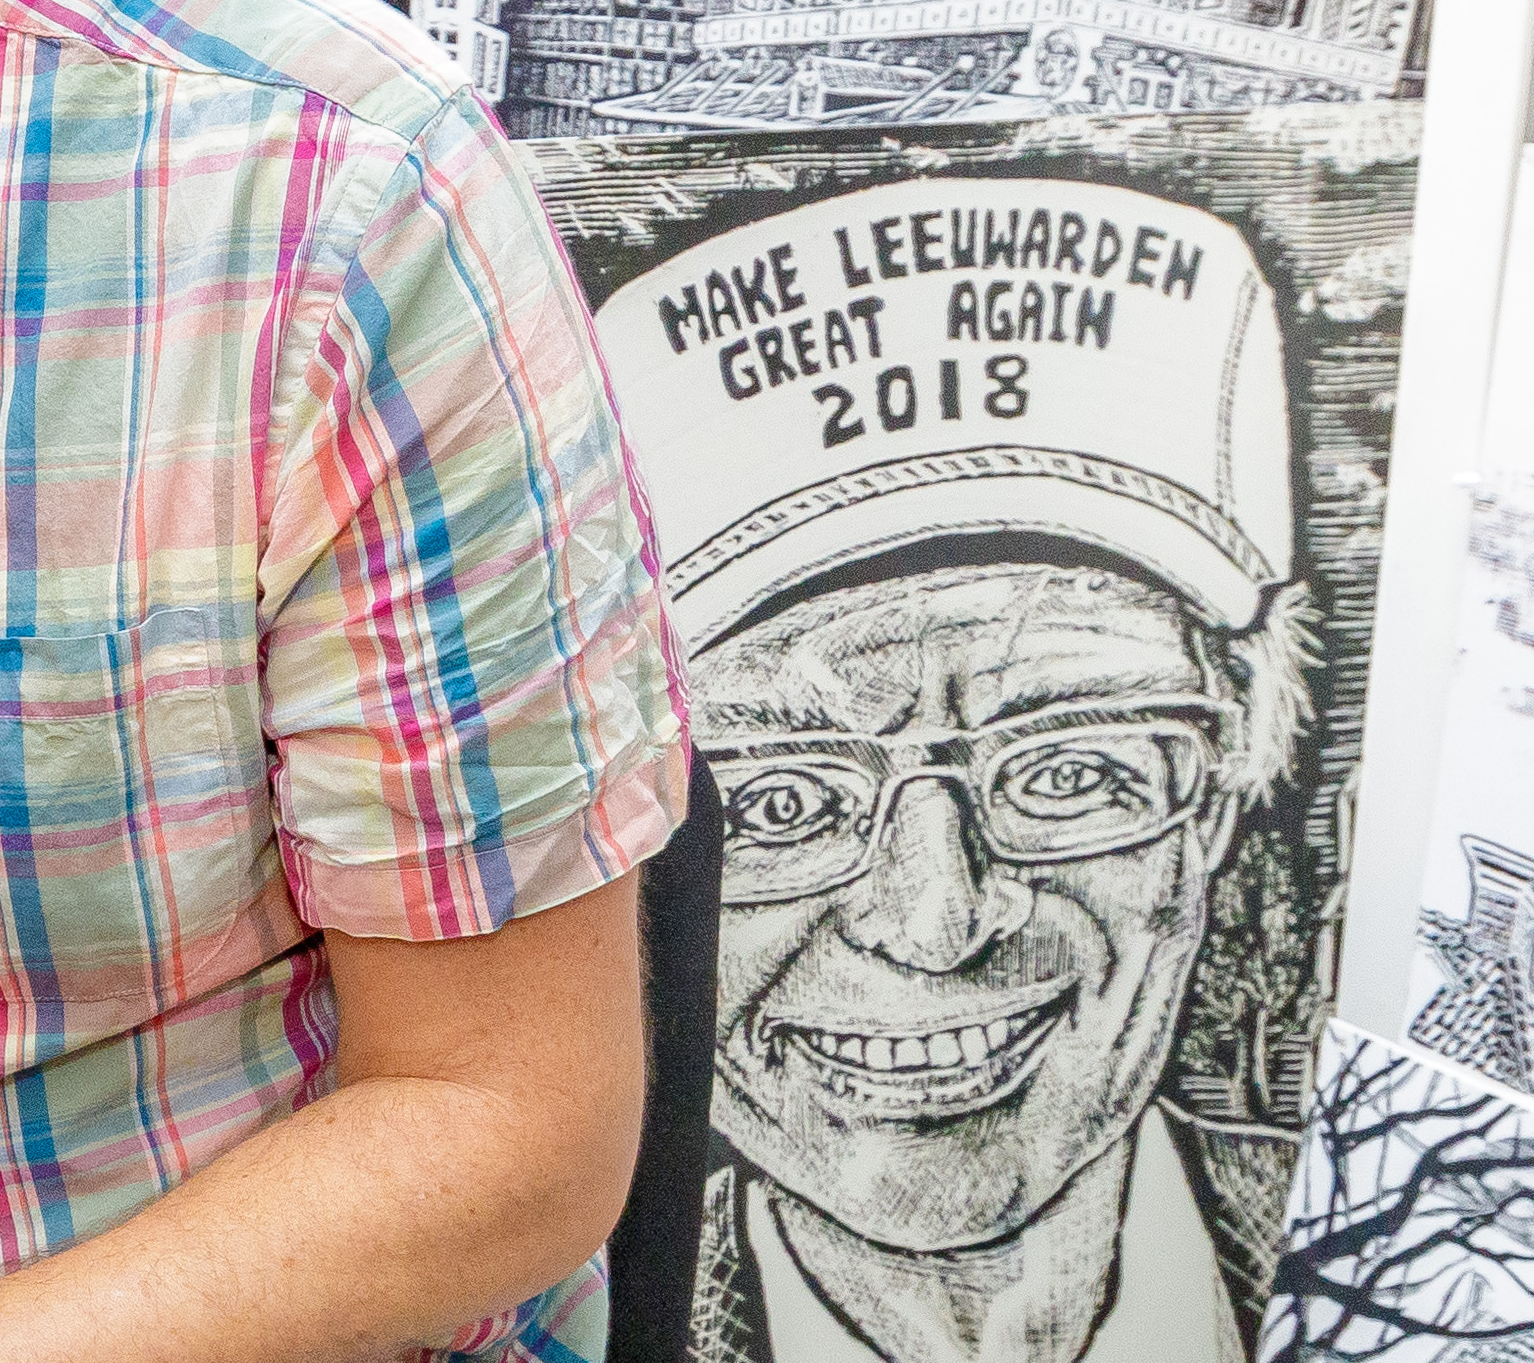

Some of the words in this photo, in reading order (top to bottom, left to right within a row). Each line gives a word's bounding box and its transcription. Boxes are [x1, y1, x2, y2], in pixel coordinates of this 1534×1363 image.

[658, 242, 808, 354] MAKE
[832, 207, 1205, 301] LEEUWARDEN
[717, 296, 886, 401] GREAT
[945, 279, 1119, 349] AGAIN
[810, 352, 1032, 449] 2018
